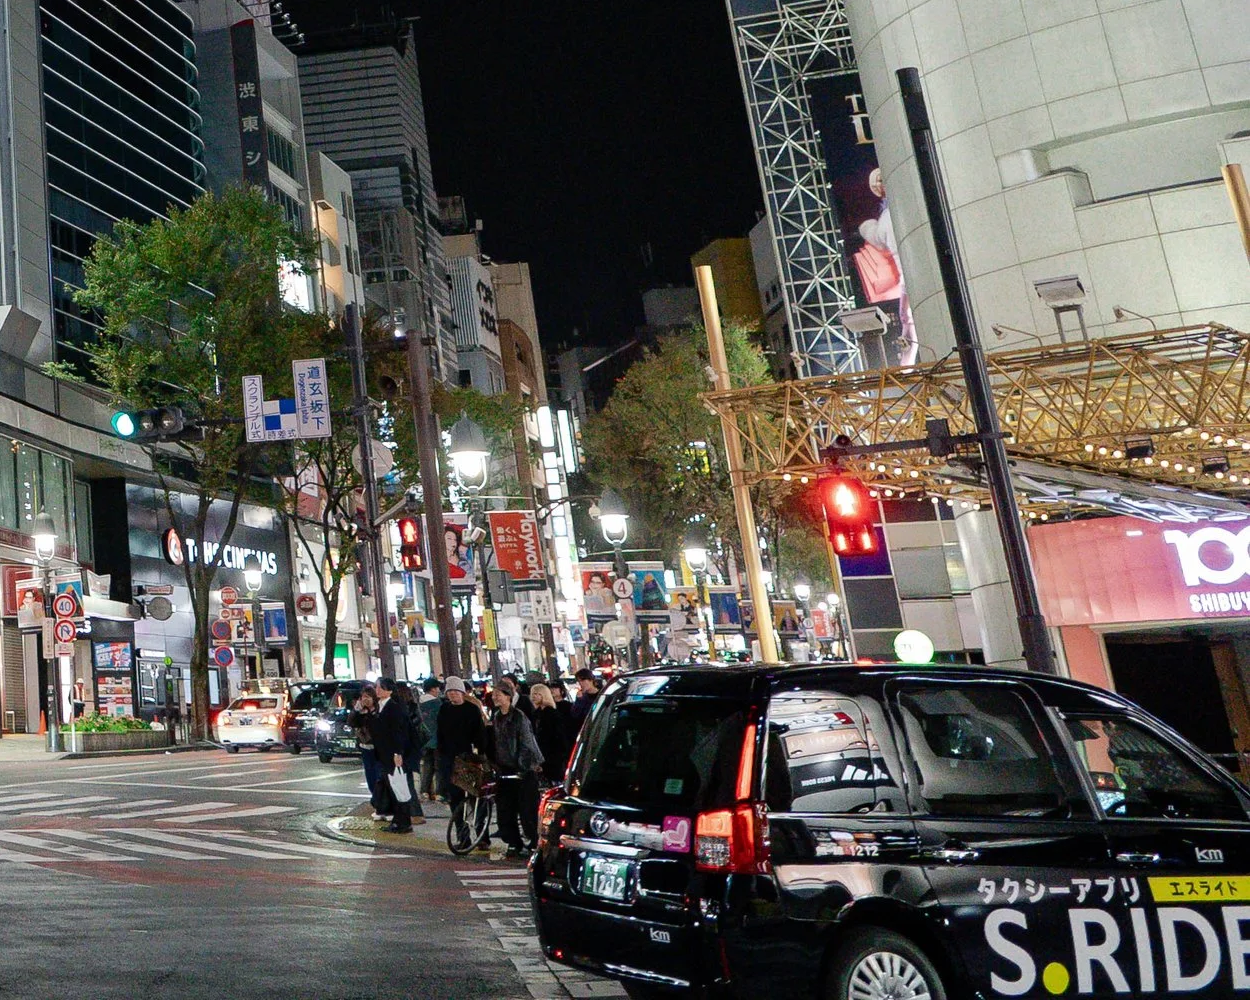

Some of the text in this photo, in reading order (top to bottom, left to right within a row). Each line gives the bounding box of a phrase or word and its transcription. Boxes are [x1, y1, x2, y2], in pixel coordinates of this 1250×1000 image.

[307, 366, 325, 430] 道玄坂下
[248, 379, 261, 439] スクランブル式
[268, 428, 296, 439] 時差式
[618, 582, 627, 595] 4
[58, 602, 71, 612] 40
[1195, 847, 1224, 863] km
[977, 877, 1238, 904] タクシーアプリ エスライド
[649, 927, 671, 943] km
